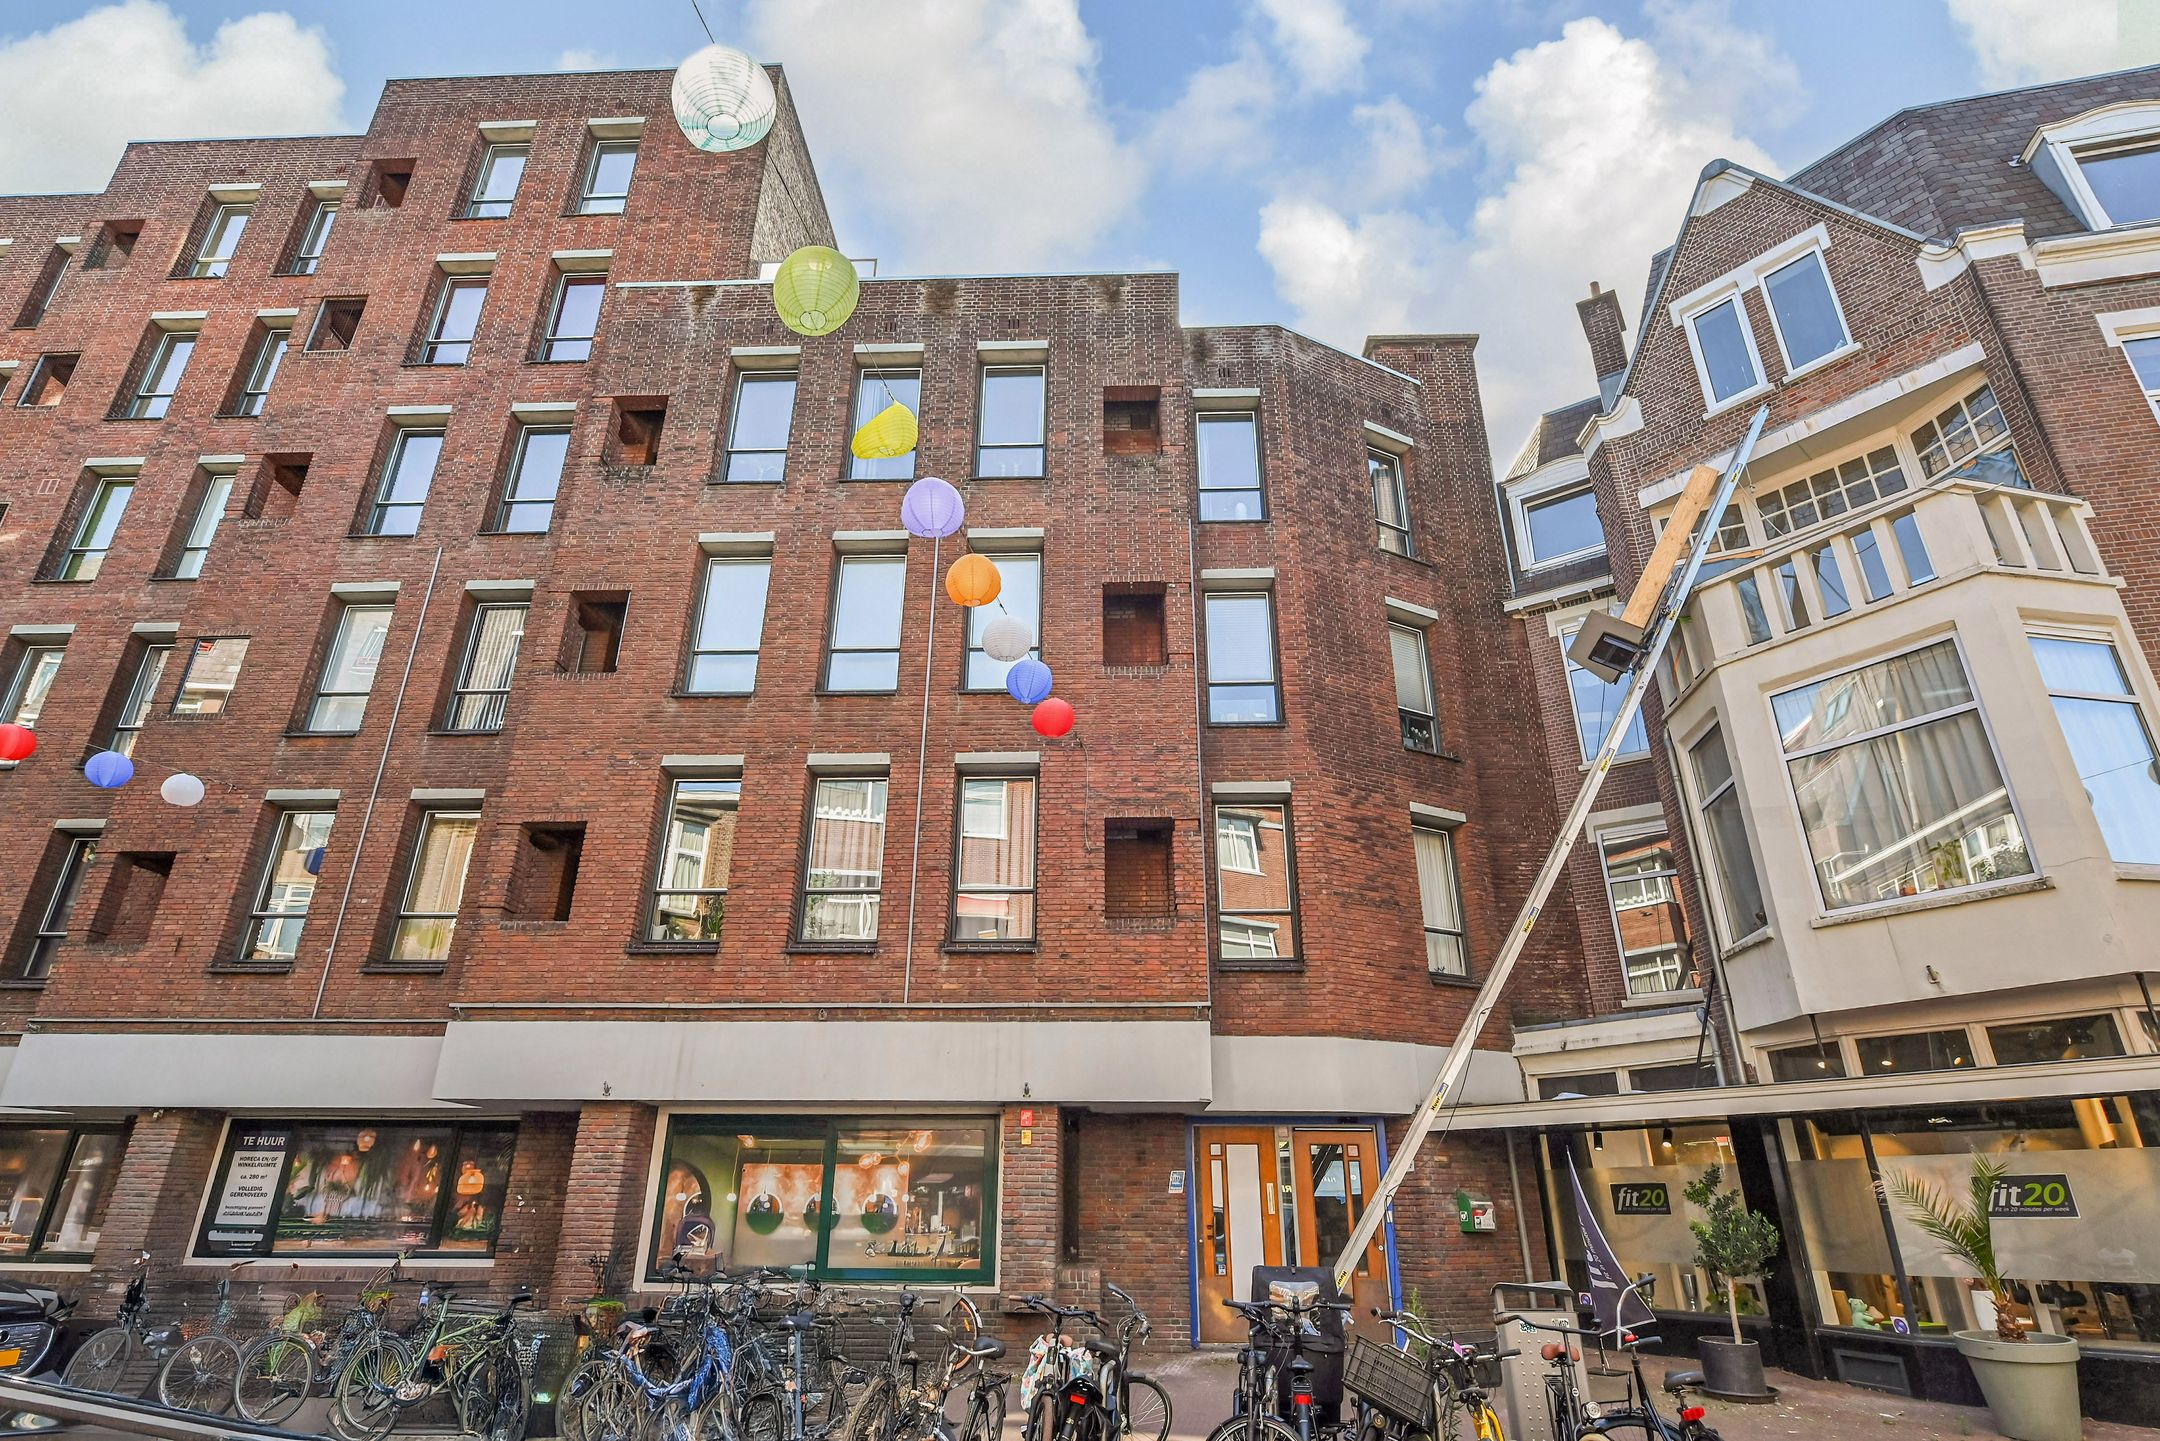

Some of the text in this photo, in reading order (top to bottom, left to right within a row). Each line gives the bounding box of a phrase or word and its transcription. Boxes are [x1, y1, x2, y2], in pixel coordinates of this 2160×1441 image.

[1431, 1097, 1440, 1110] Huur
[243, 1136, 286, 1146] TE HUUR
[1617, 1186, 1665, 1211] fit20
[1988, 1180, 2065, 1212] fit20
[1337, 1271, 1347, 1285] Huur
